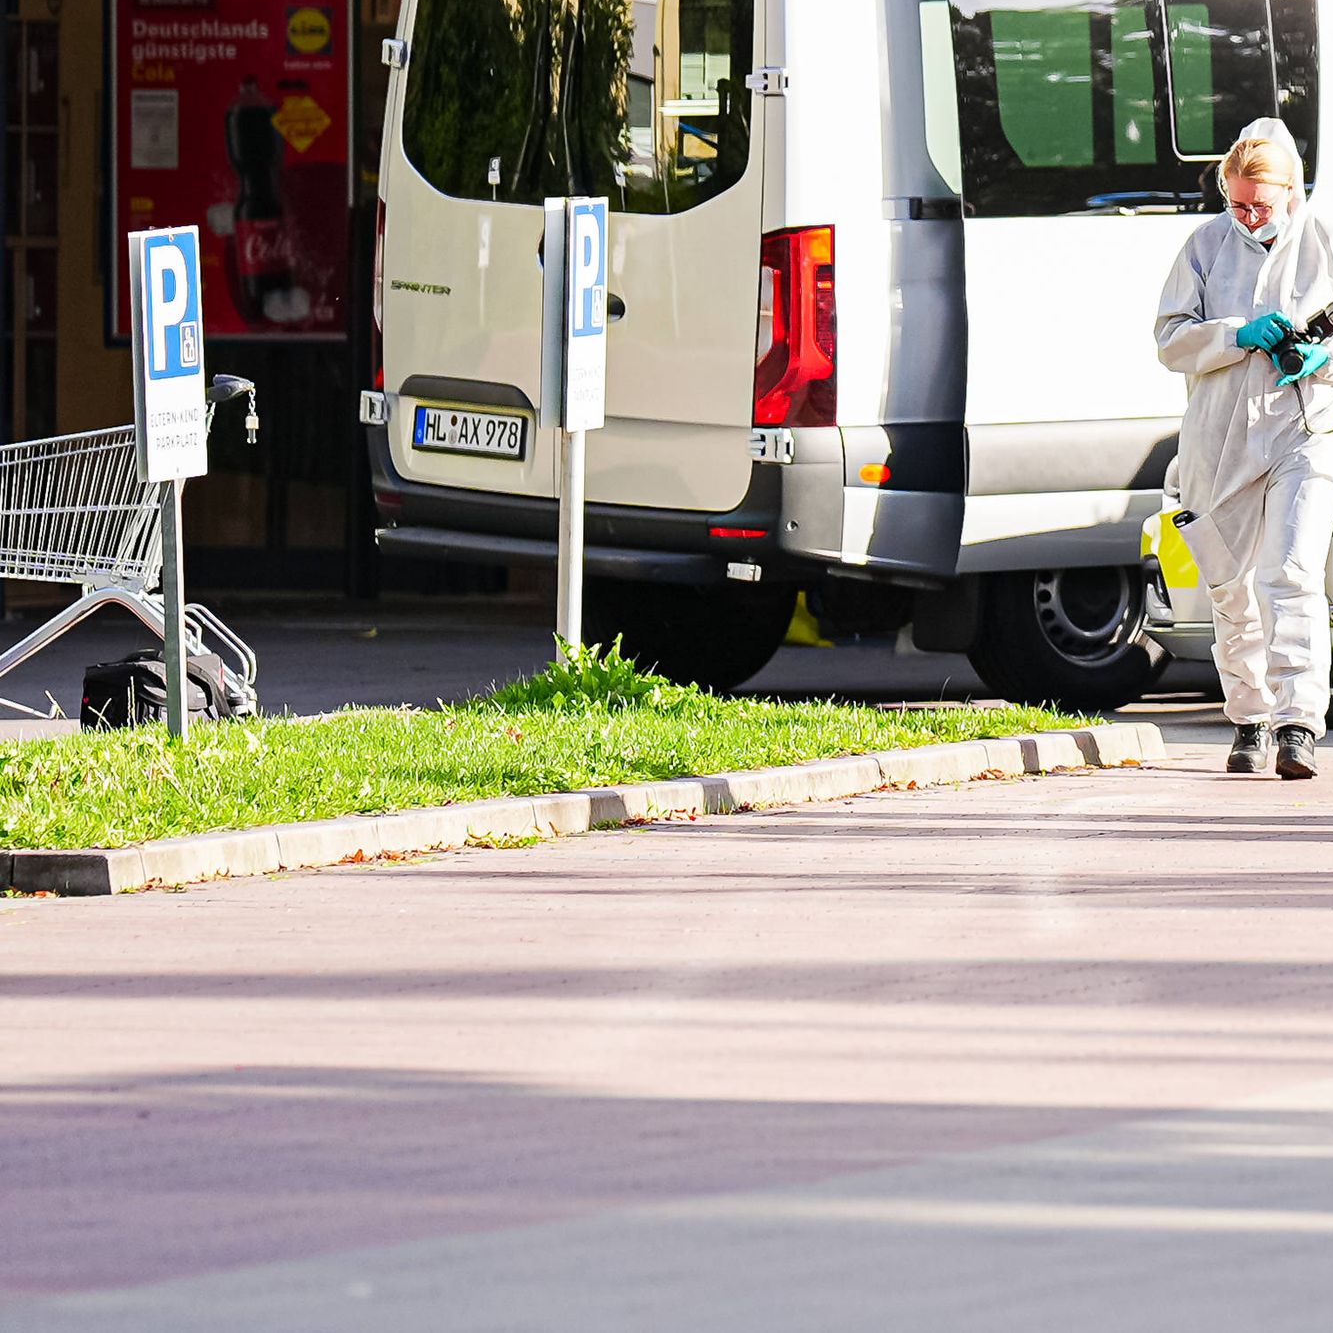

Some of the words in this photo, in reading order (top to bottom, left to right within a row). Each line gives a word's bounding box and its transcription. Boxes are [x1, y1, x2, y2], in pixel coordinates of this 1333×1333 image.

[132, 19, 269, 39] Deutschlands
[132, 41, 237, 63] günstigste
[131, 62, 176, 82] Cola
[575, 213, 600, 331] P
[149, 244, 190, 372] P
[425, 408, 447, 442] HL
[458, 416, 481, 446] AX
[485, 420, 519, 449] 978
